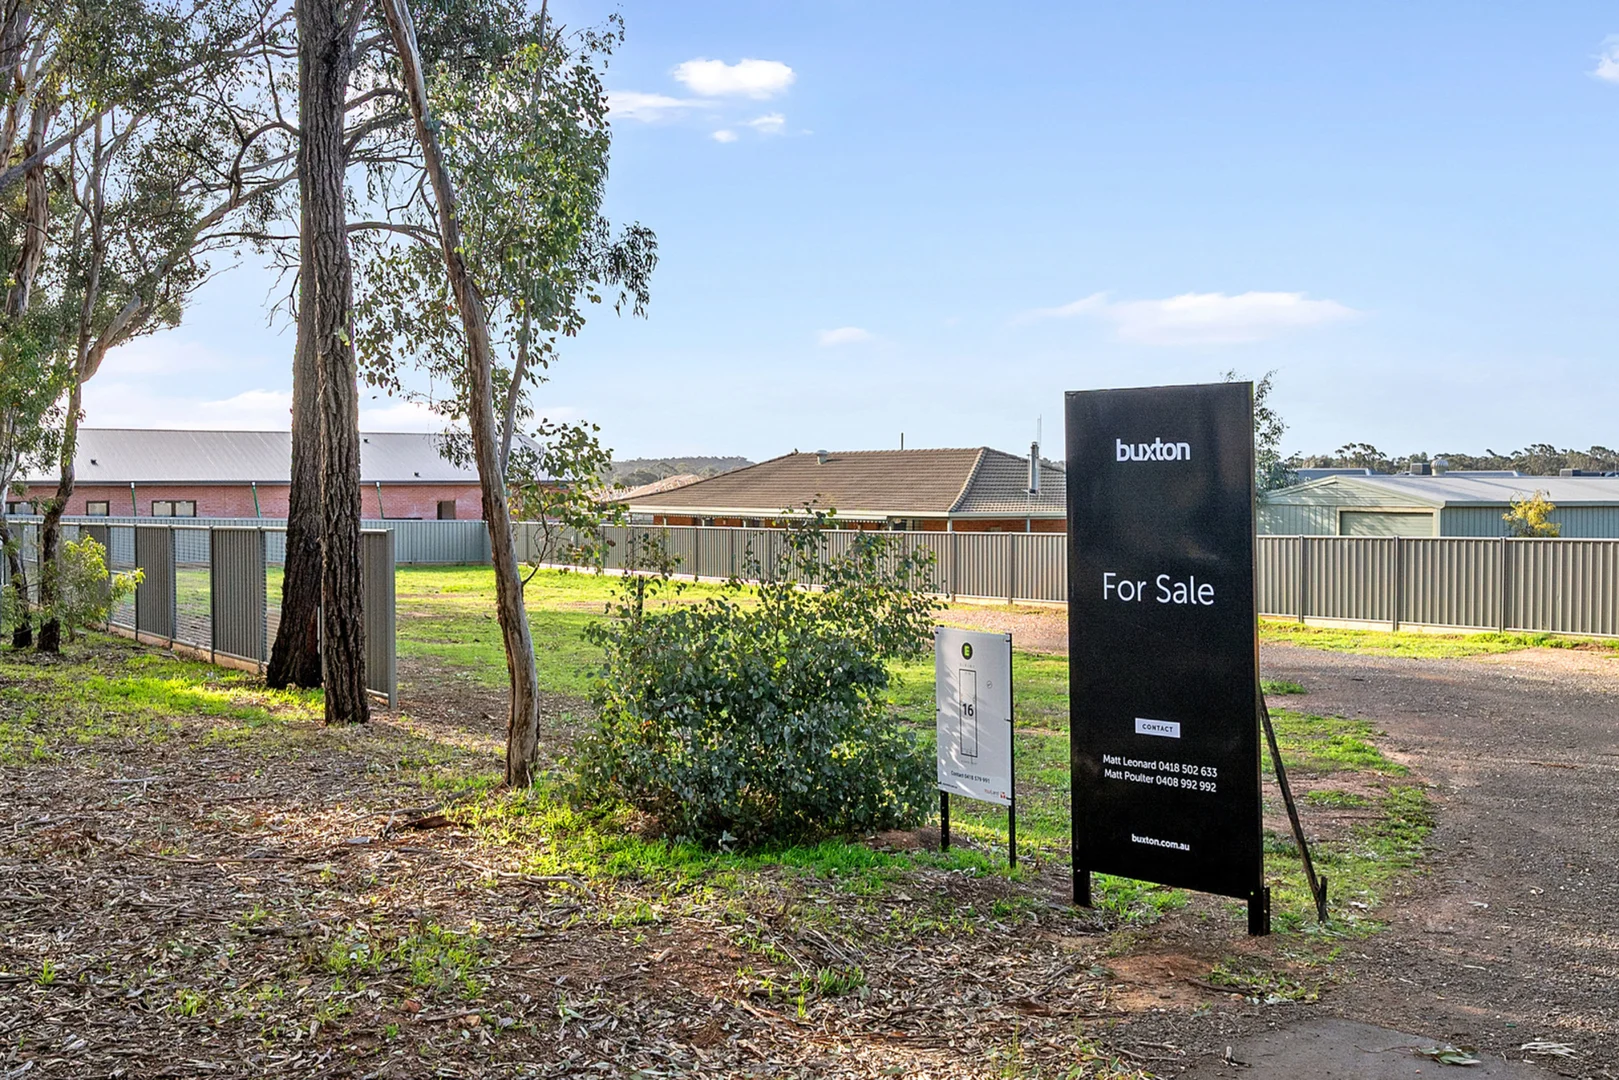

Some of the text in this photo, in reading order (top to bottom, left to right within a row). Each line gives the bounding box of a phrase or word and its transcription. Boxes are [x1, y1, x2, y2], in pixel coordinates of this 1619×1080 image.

[1116, 437, 1190, 461] buxton
[1103, 572, 1215, 605] For Sale
[964, 645, 970, 656] E
[962, 703, 974, 717] 16
[1142, 723, 1174, 732] CONTACT
[1103, 754, 1218, 778] Matt Leonard 0418 502 633
[1104, 768, 1217, 793] Matt Poulter 0408 992 992
[1131, 833, 1190, 851] buxton.com.au
